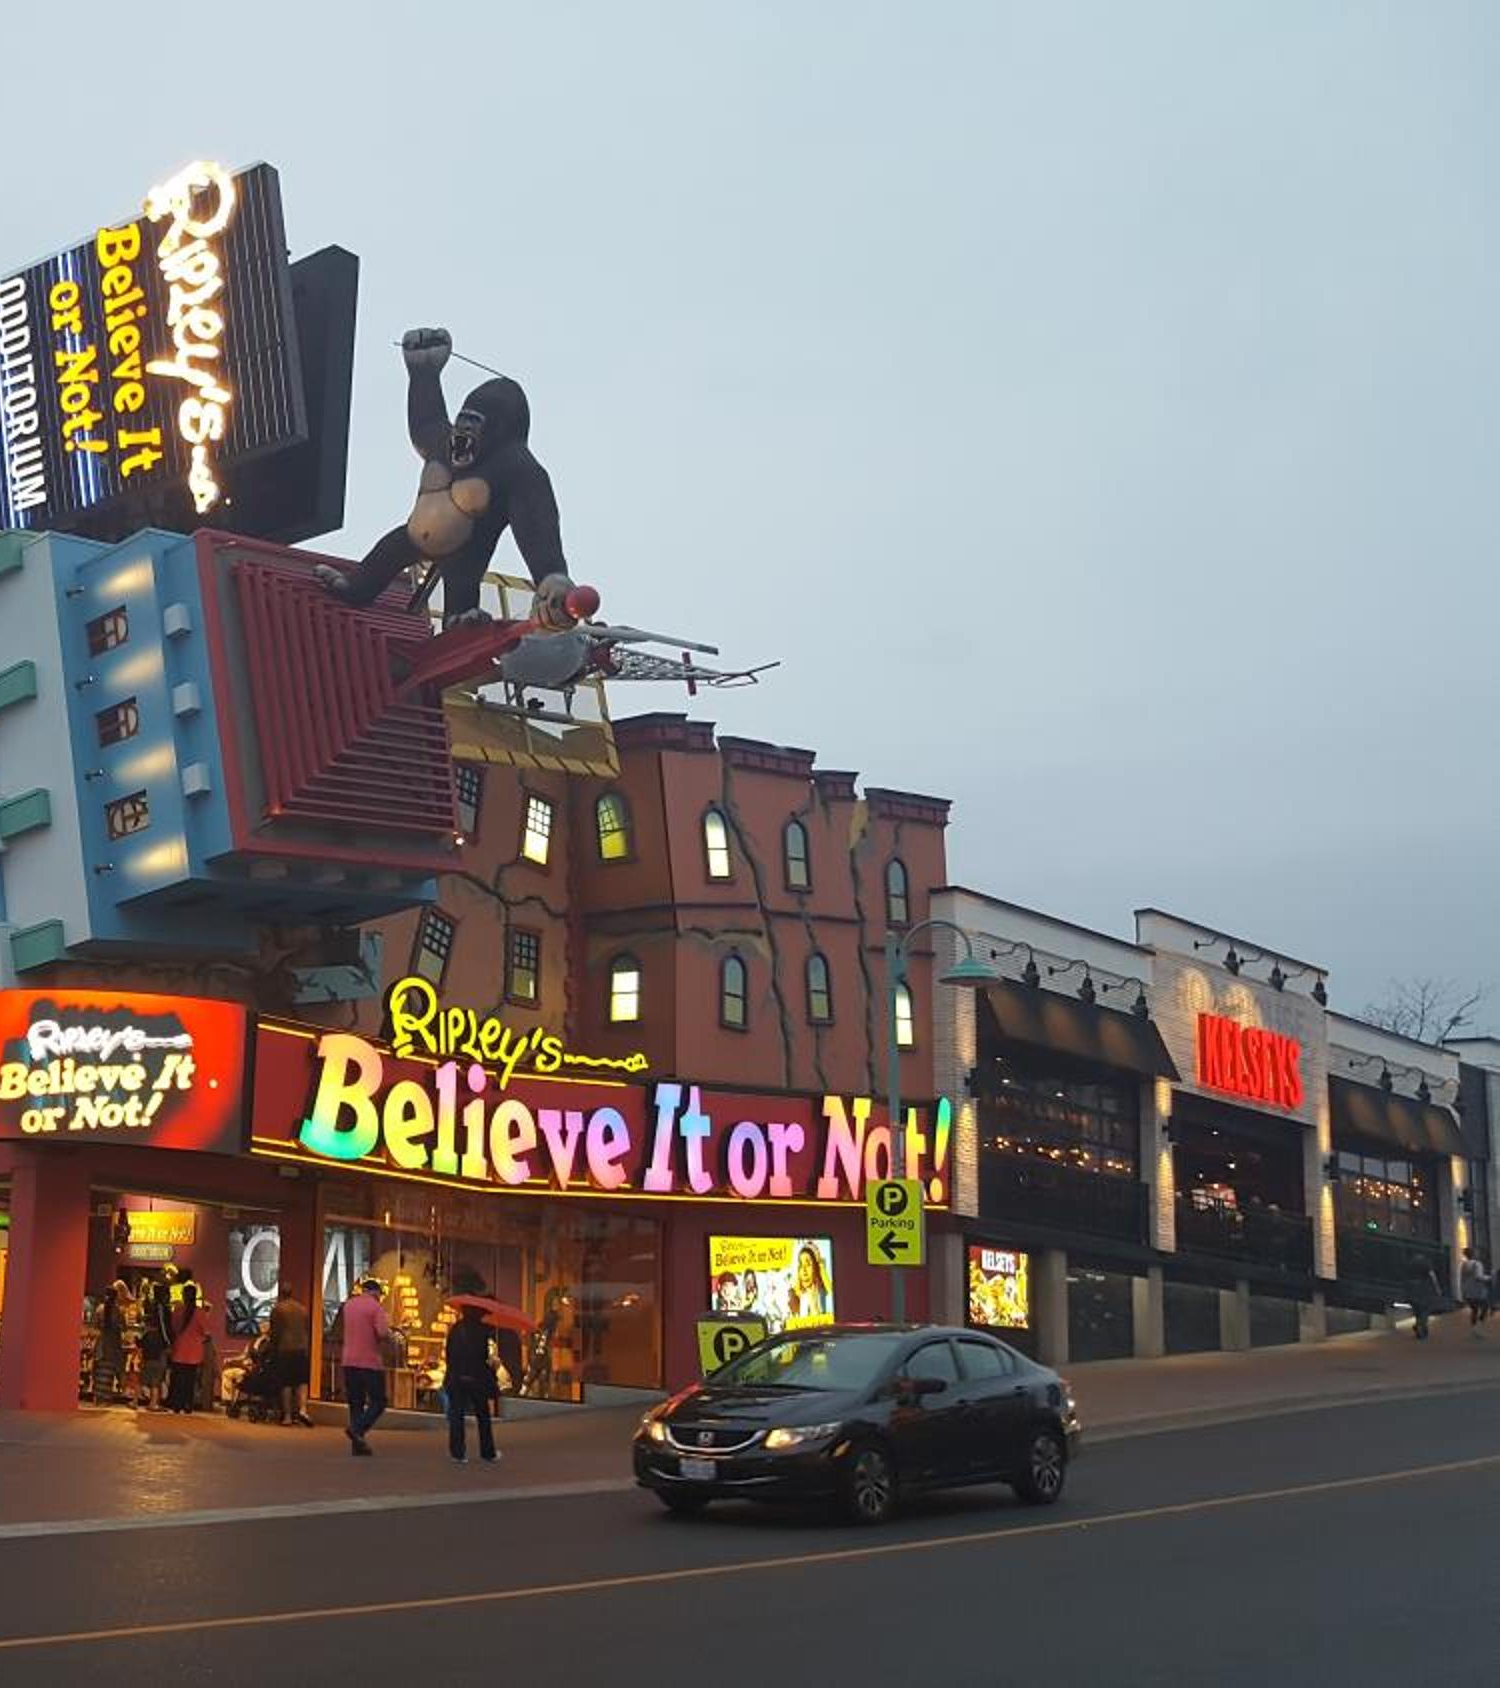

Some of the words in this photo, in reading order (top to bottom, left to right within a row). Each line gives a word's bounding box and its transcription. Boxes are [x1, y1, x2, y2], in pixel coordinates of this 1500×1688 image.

[49, 280, 83, 335] or
[96, 223, 148, 413] Believe
[54, 345, 109, 453] Not!
[117, 427, 164, 478] It
[152, 1054, 196, 1090] It
[1198, 1013, 1303, 1108] KELSEYS
[20, 1106, 66, 1133] or
[68, 1091, 164, 1130] Not!
[300, 1033, 632, 1192] Believe
[643, 1083, 713, 1194] It
[727, 1121, 805, 1198] or
[817, 1095, 951, 1202] Not!
[870, 1217, 915, 1231] Parking
